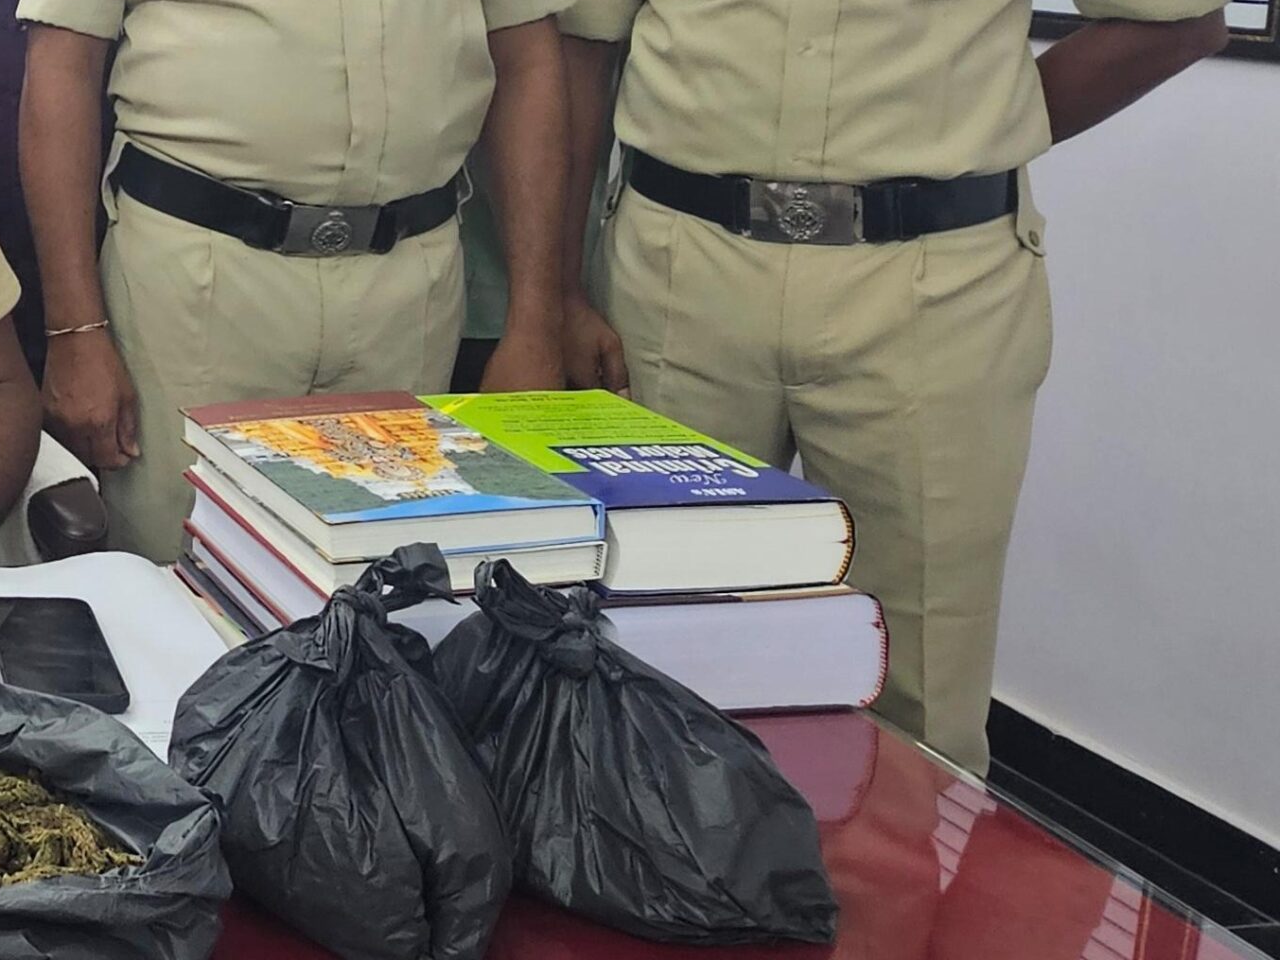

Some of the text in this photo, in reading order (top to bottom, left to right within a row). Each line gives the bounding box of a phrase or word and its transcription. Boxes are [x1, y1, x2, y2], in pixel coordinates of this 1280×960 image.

[563, 445, 720, 461] Major Acts
[589, 458, 760, 478] Criminal
[670, 473, 728, 486] New
